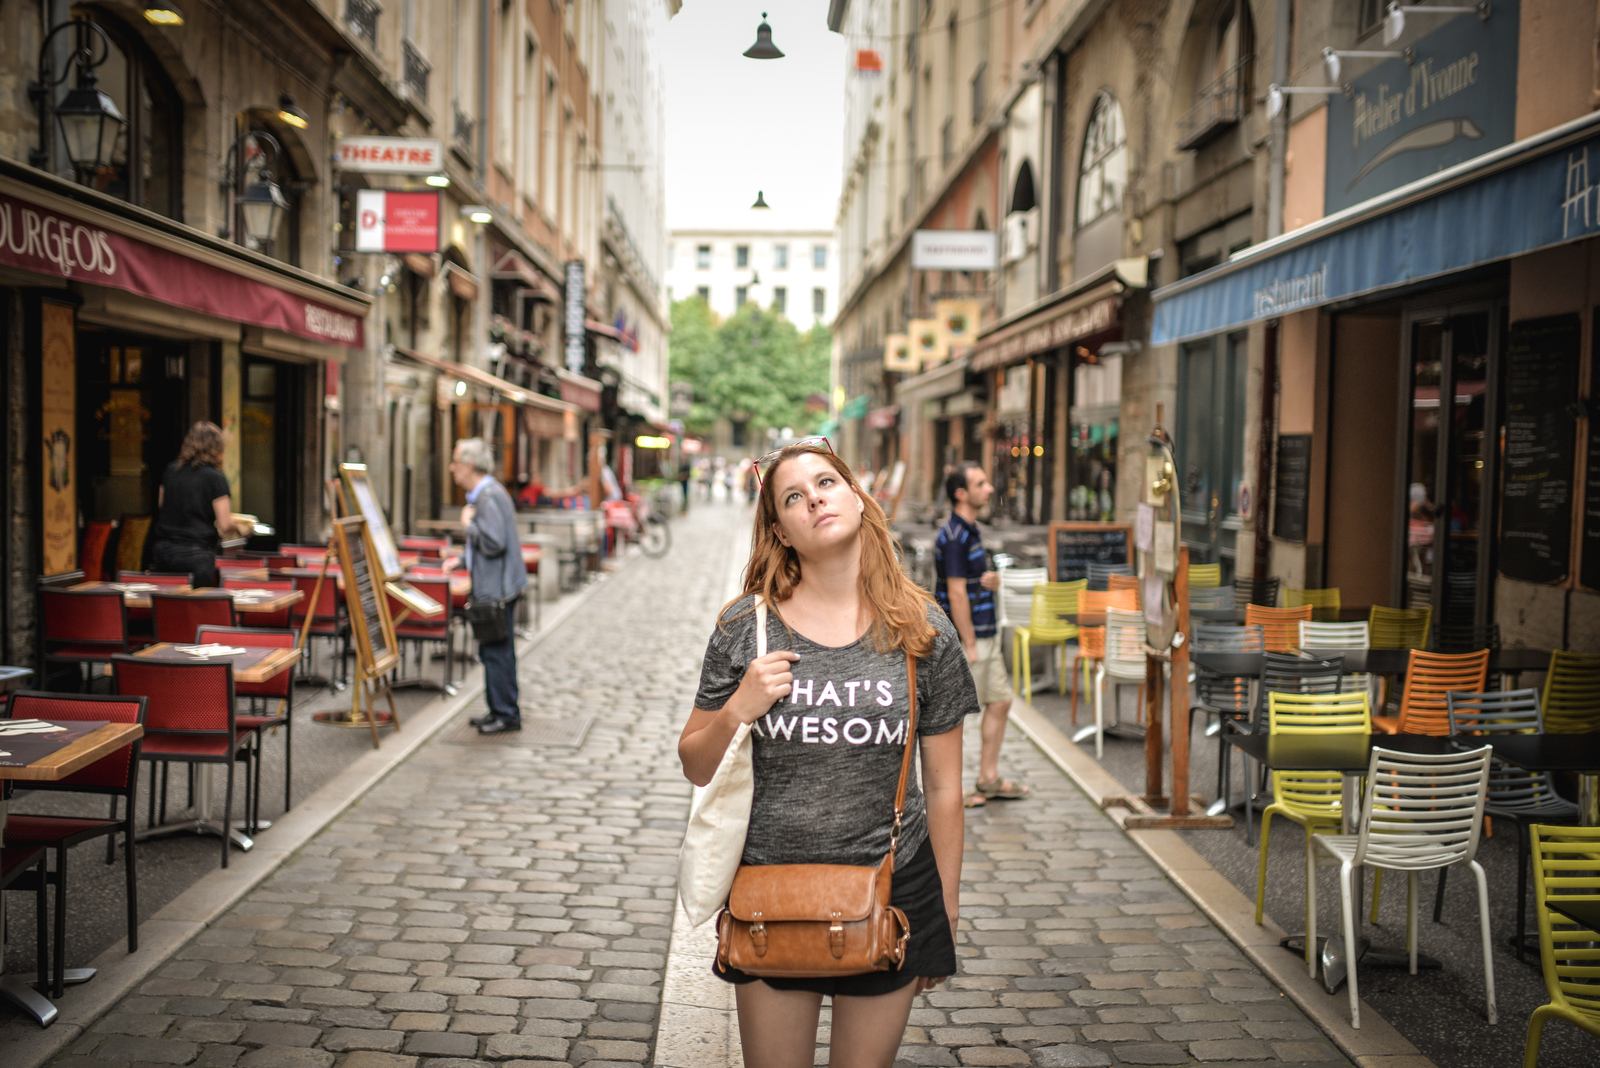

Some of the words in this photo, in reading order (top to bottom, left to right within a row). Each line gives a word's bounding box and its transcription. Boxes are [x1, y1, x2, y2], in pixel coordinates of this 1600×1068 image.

[1353, 84, 1403, 147] Atelier
[341, 144, 433, 165] THEATRE
[0, 202, 116, 276] URGEOIS
[1253, 263, 1327, 317] restaurant
[778, 679, 893, 706] HAT'S
